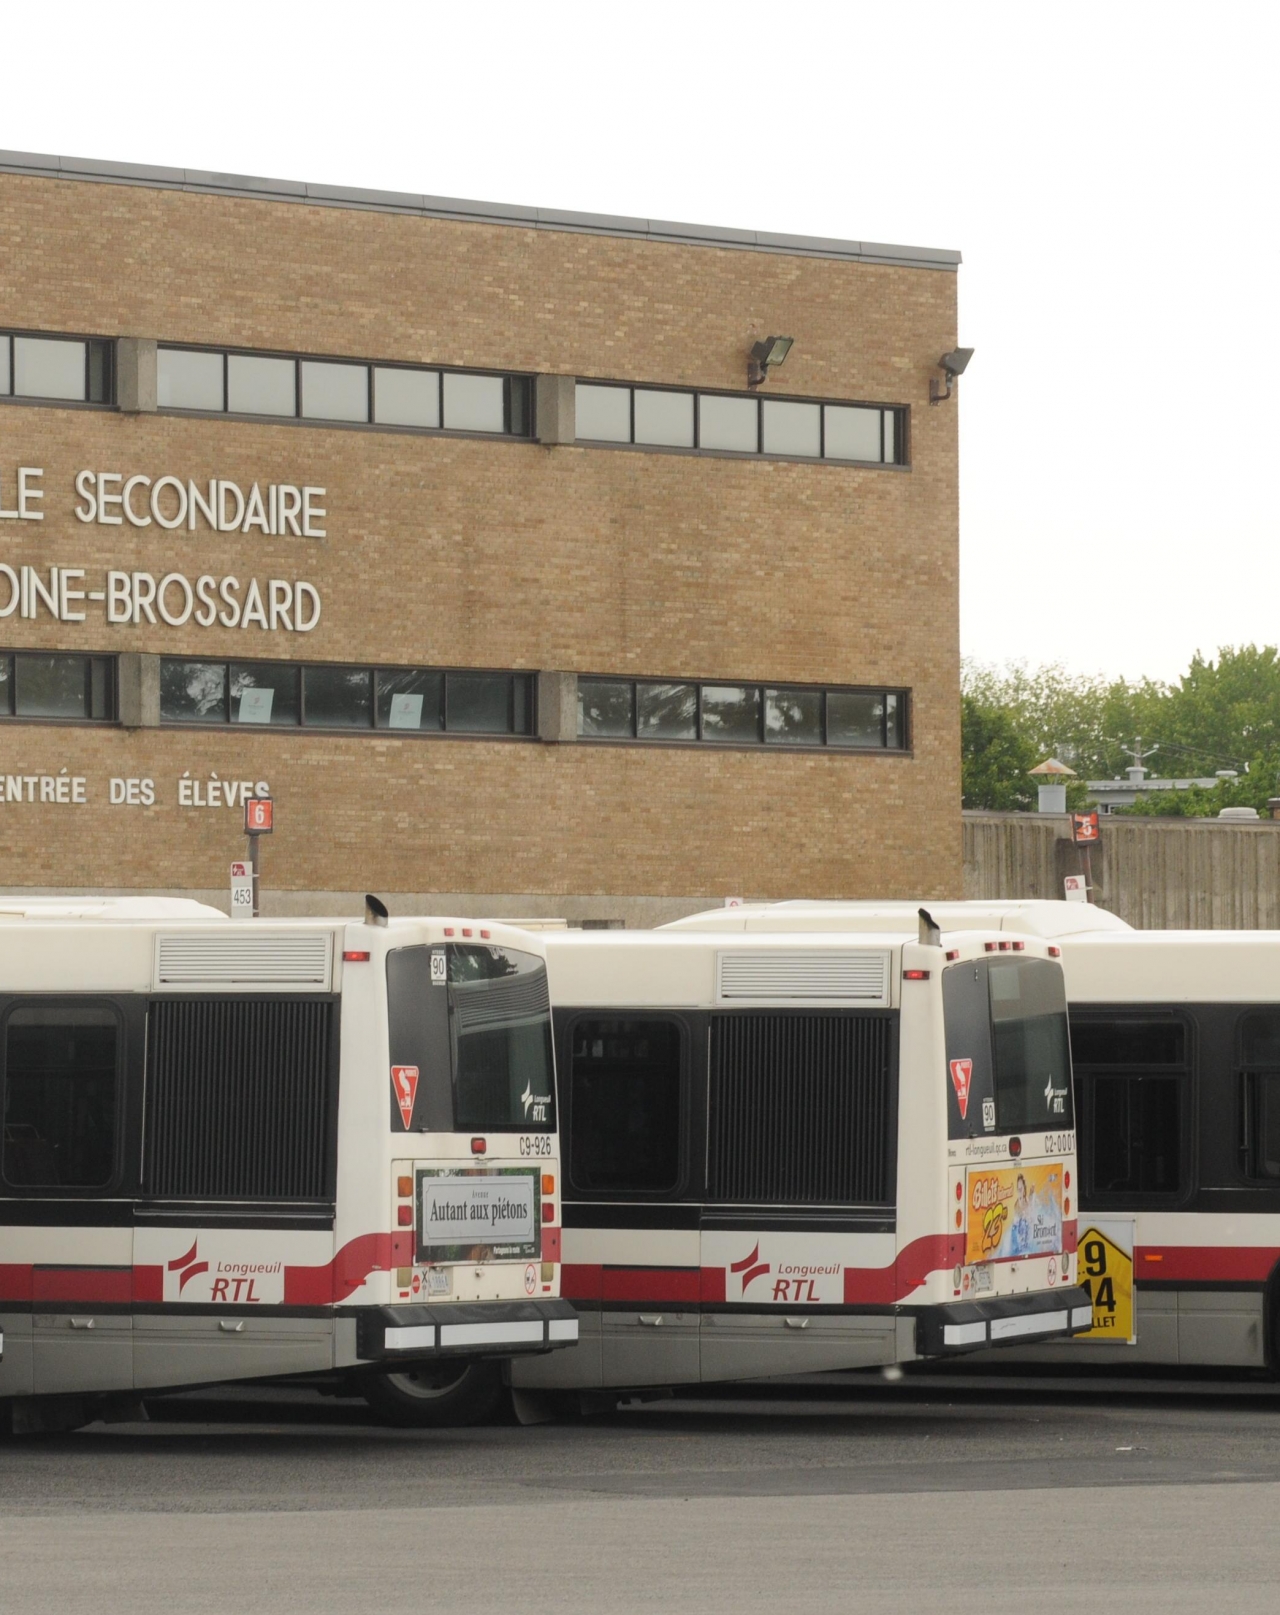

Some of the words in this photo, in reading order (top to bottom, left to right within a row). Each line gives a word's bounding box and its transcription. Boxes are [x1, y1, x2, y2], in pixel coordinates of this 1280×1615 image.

[74, 469, 327, 538] SECONDAIRE
[109, 777, 155, 806] DES
[178, 771, 270, 807] ÉLÈVES
[255, 804, 265, 824] 6
[1083, 817, 1092, 836] 5
[233, 889, 251, 904] 453
[432, 957, 445, 975] 90
[532, 1105, 547, 1121] RTL
[984, 1105, 994, 1121] 90
[1053, 1098, 1065, 1113] RTL
[520, 1136, 552, 1156] C9-926
[965, 1143, 1007, 1157] rtl-longueuil.qc.ca
[1044, 1133, 1075, 1154] C2-0001
[472, 1189, 489, 1199] Avenue
[973, 1178, 998, 1211] Billets
[429, 1199, 468, 1221] Autant
[470, 1203, 490, 1220] aux
[491, 1197, 528, 1227] piétons
[217, 1261, 282, 1276] Longueuil
[778, 1263, 841, 1277] Longueuil
[209, 1278, 261, 1302] RTL
[771, 1279, 821, 1302] RTL
